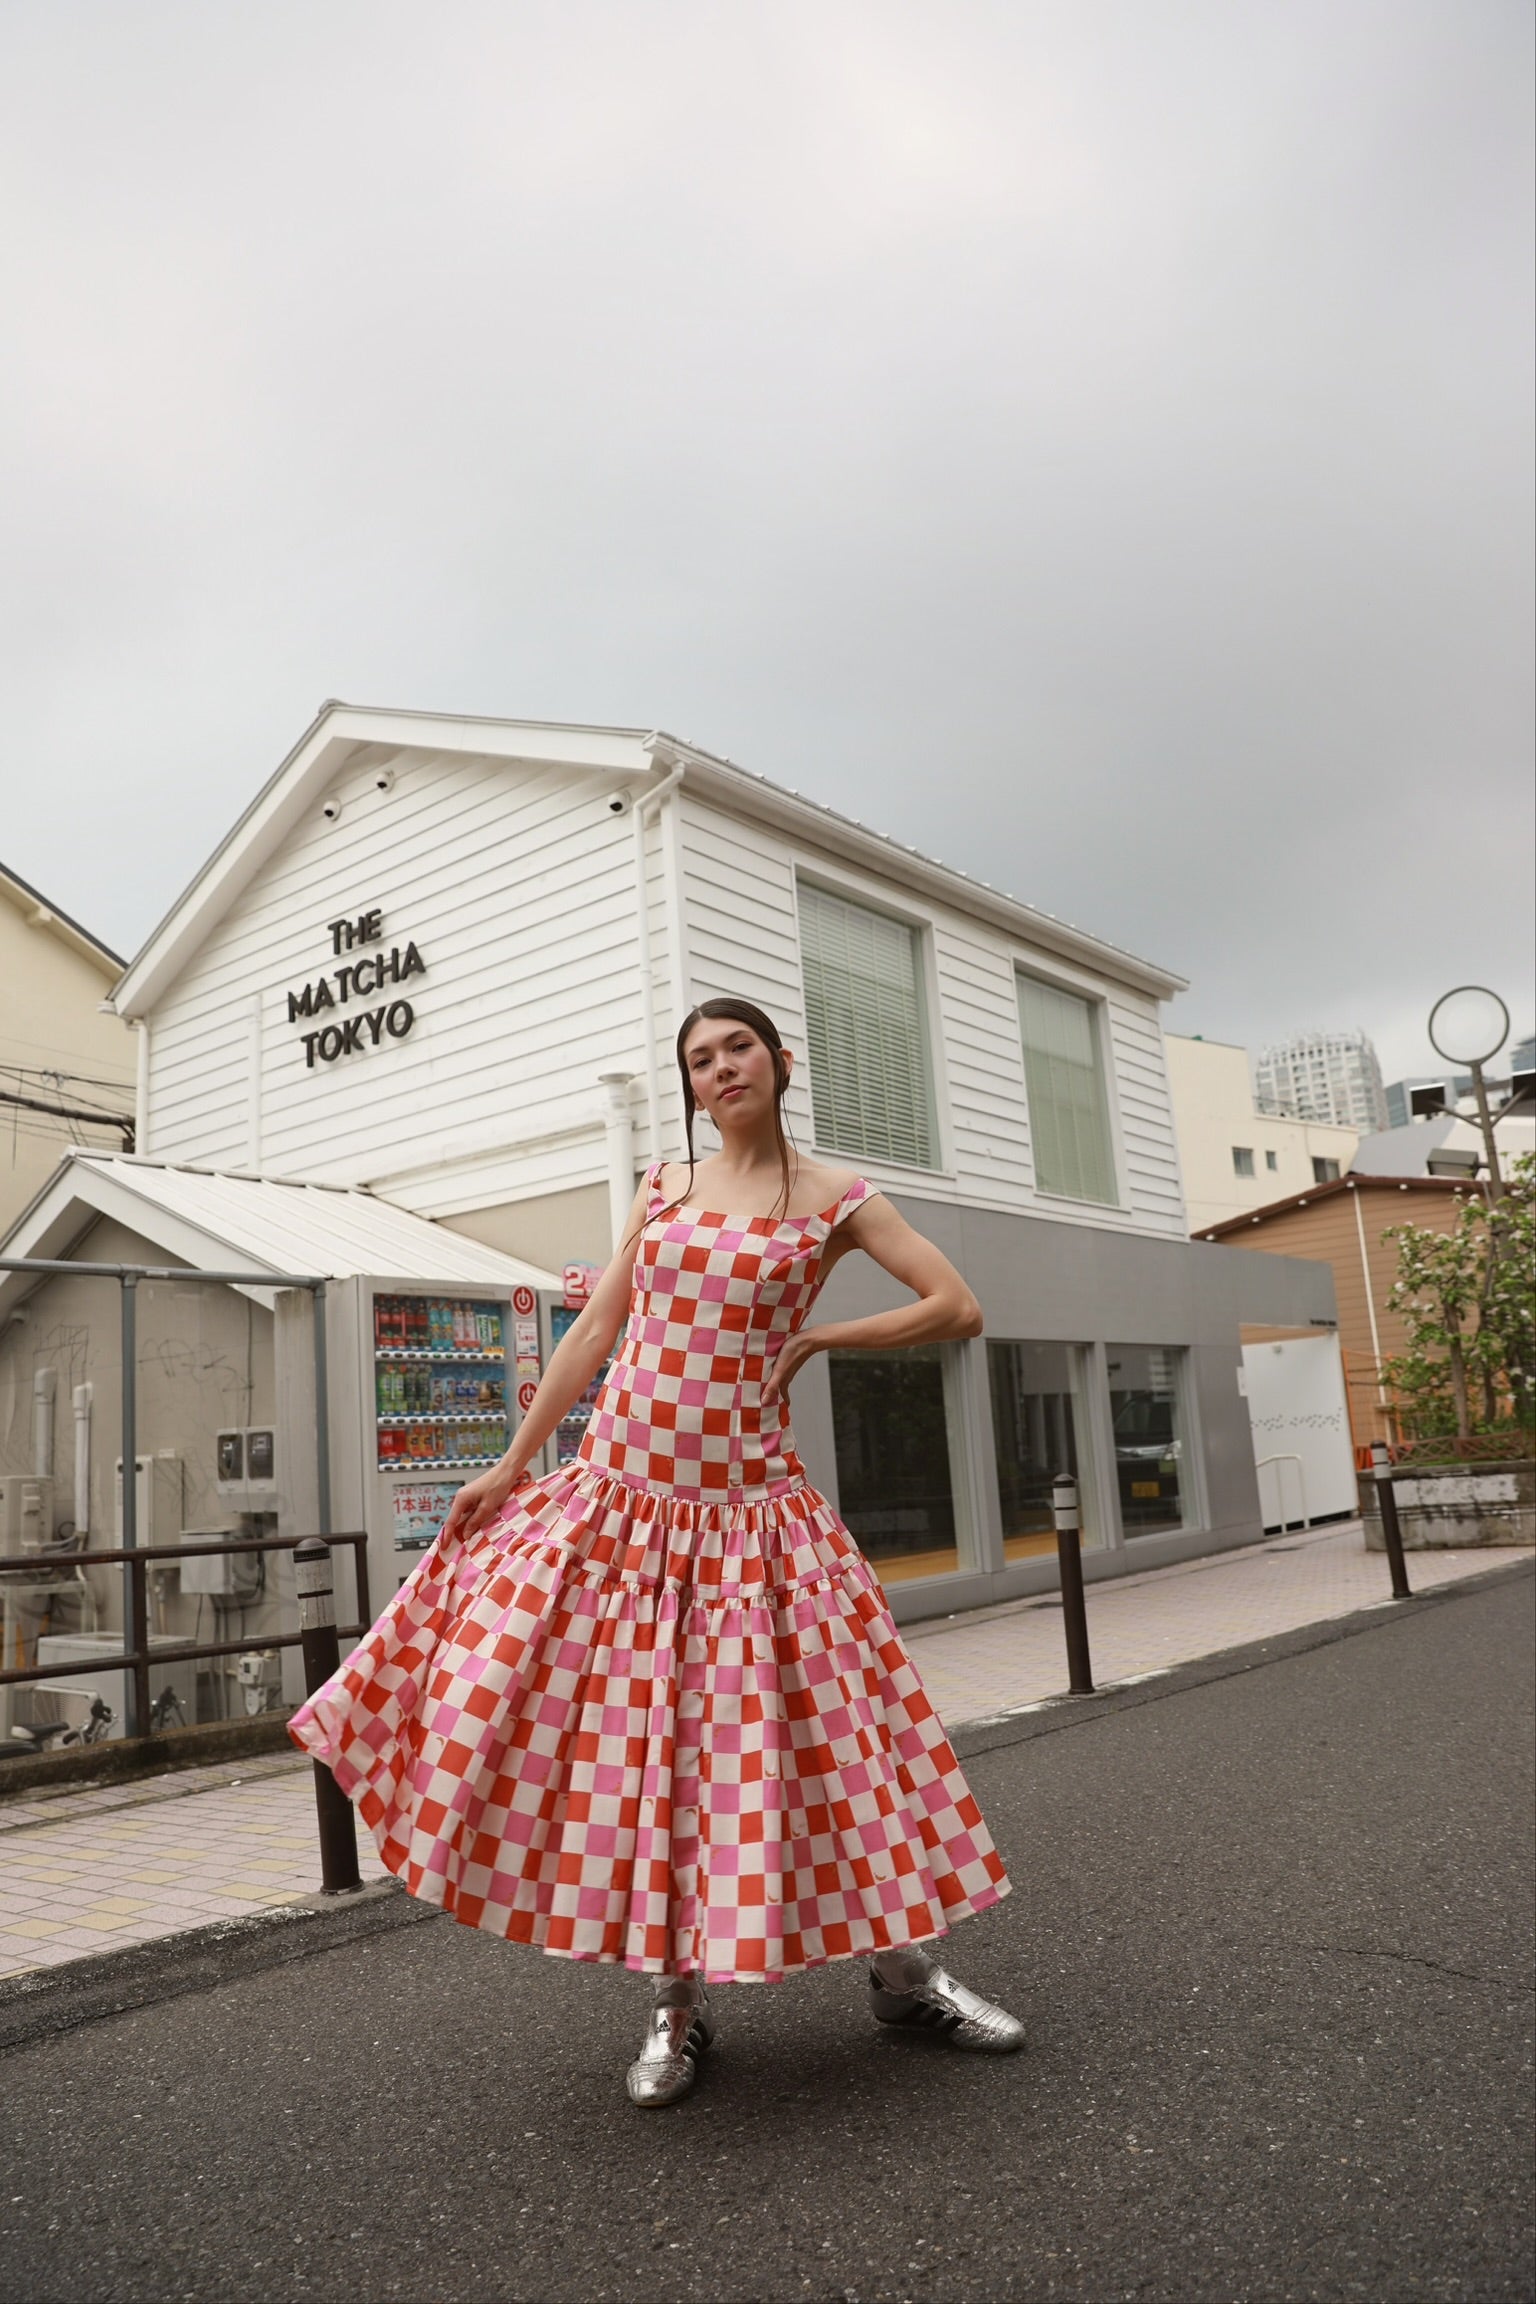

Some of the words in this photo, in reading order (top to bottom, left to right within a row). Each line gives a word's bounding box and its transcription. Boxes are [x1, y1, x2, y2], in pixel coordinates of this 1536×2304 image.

[328, 908, 382, 955] THE
[288, 941, 426, 1023] MATCHA
[301, 1000, 414, 1068] TOKYO
